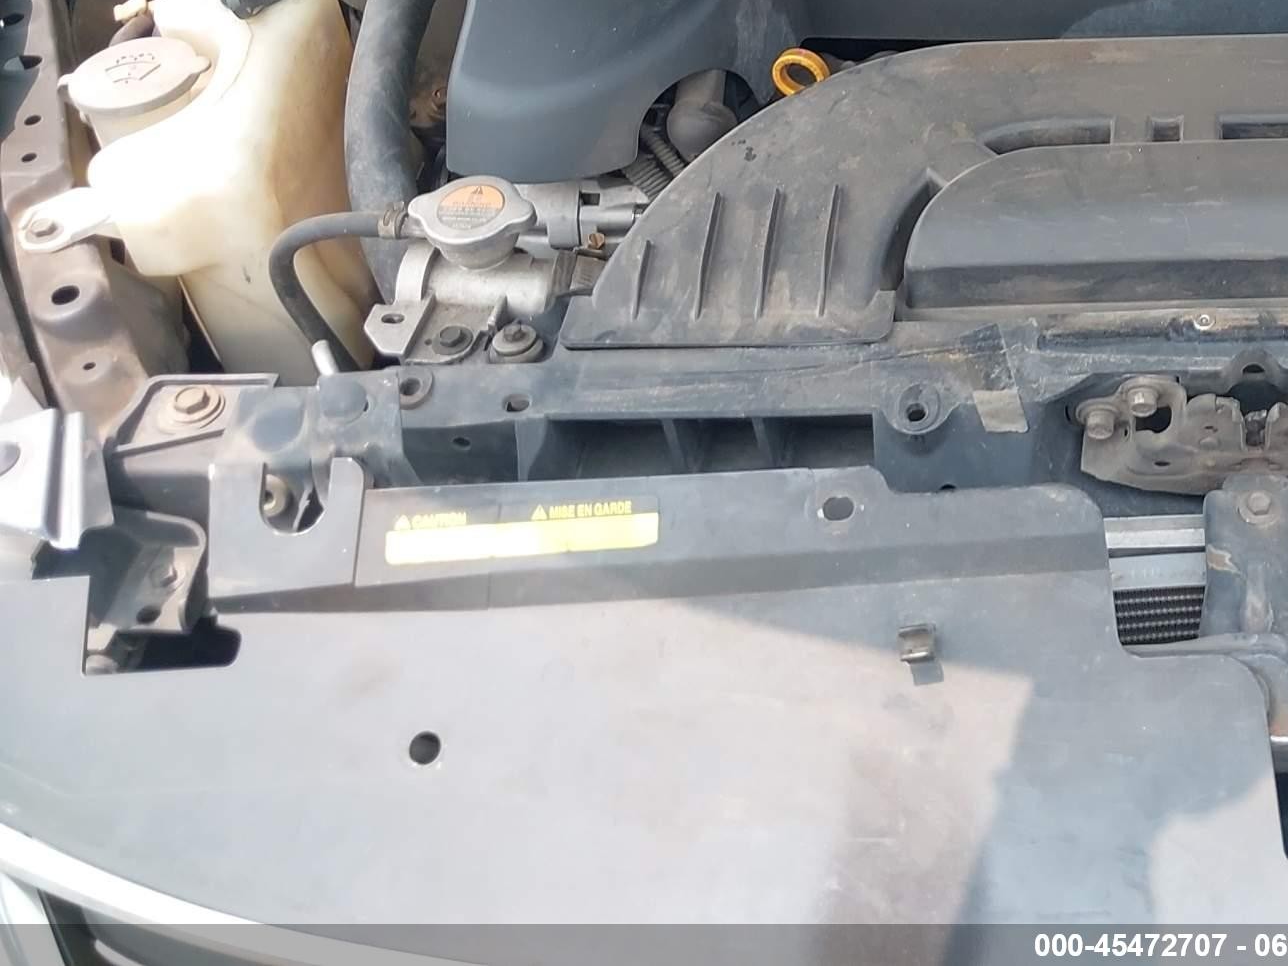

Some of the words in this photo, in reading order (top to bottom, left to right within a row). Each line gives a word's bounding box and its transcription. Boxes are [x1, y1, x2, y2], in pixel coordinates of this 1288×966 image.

[549, 505, 576, 519] MISE
[577, 503, 593, 518] EN
[594, 500, 632, 516] GARDE
[411, 512, 467, 530] CAUTION
